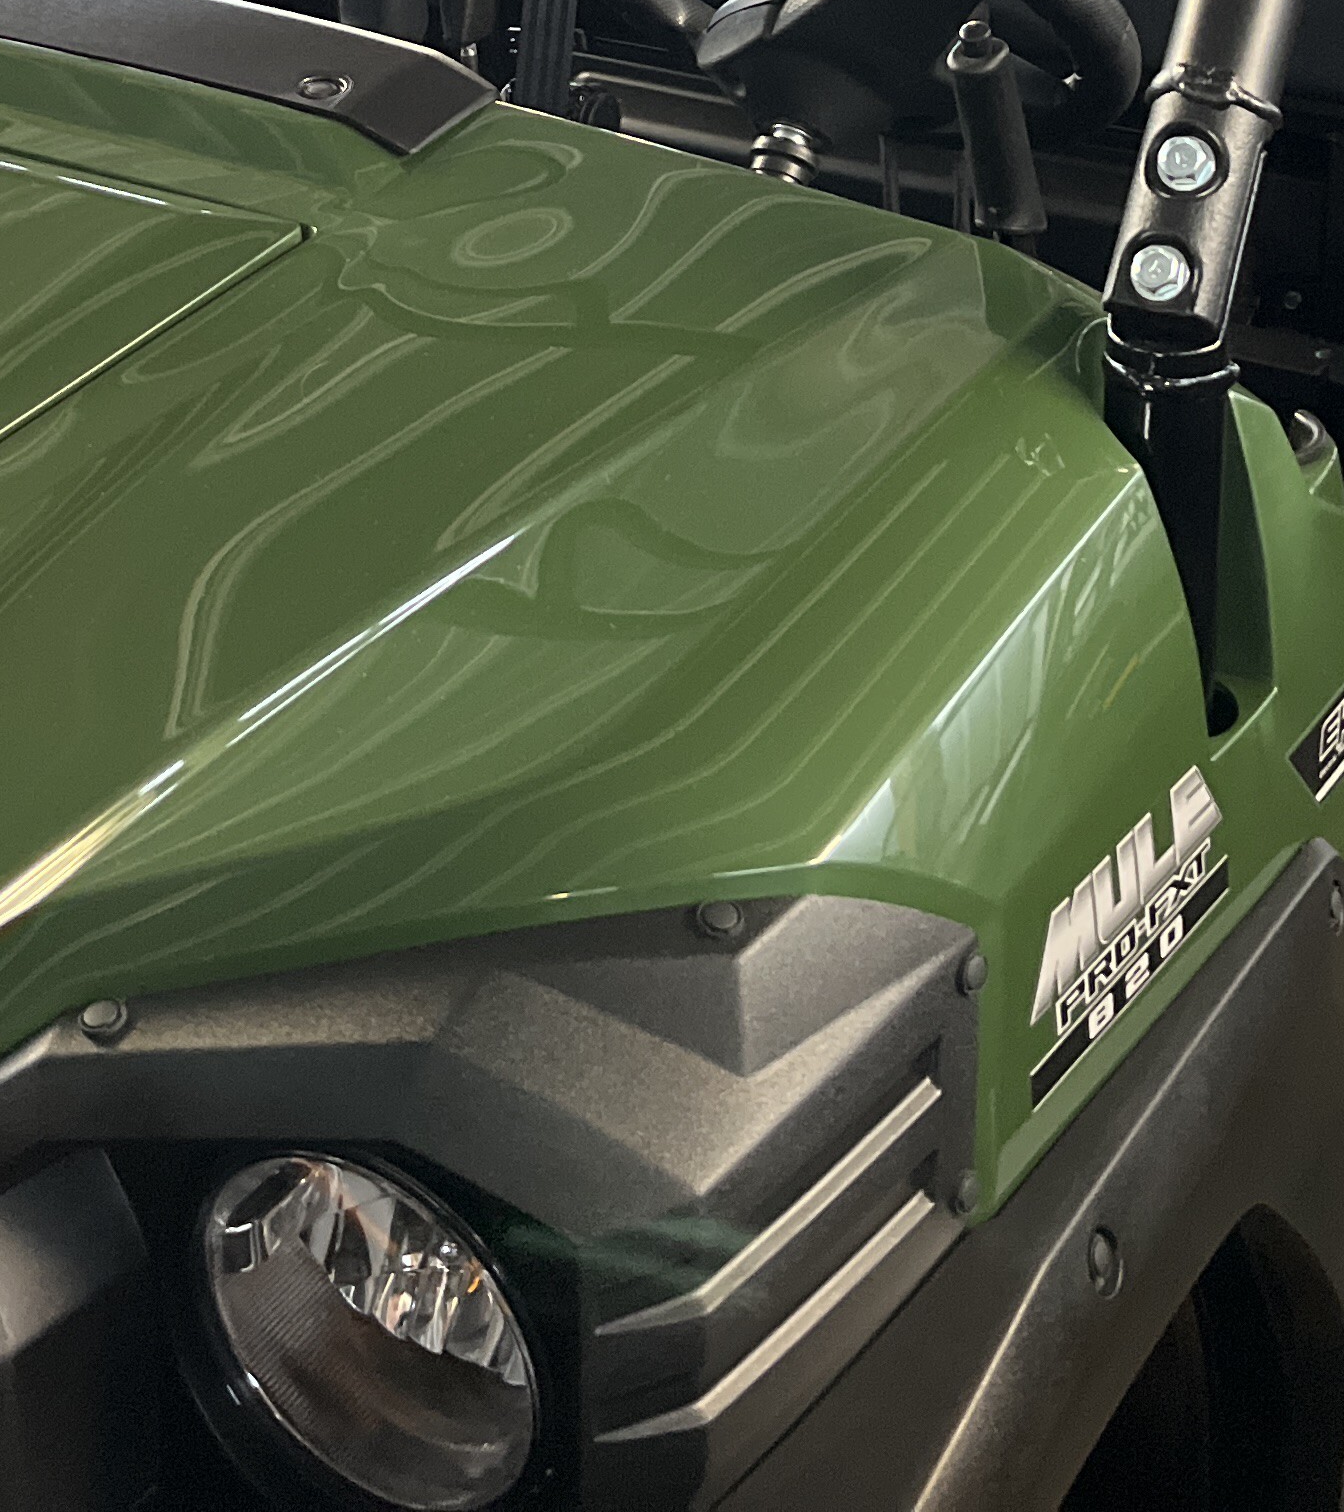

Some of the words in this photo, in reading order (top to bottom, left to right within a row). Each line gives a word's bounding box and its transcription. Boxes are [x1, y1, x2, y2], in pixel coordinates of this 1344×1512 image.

[1029, 764, 1223, 1027] MULE
[1055, 836, 1212, 1036] PRO-FXT
[1087, 913, 1184, 1040] 820
